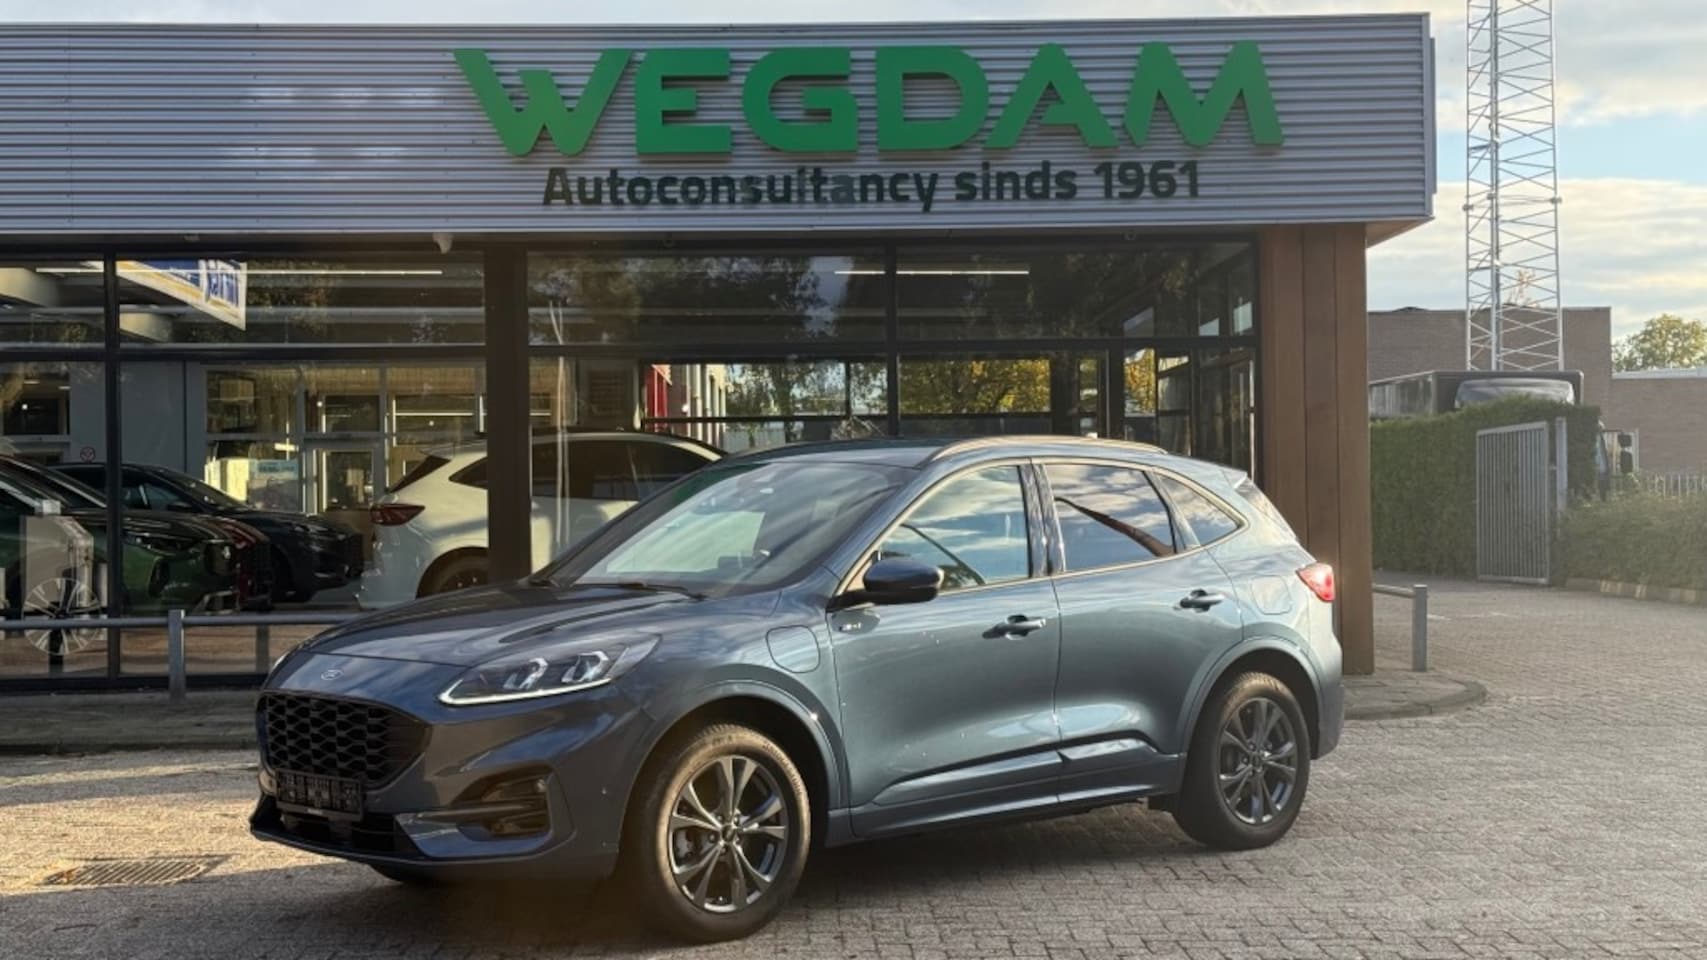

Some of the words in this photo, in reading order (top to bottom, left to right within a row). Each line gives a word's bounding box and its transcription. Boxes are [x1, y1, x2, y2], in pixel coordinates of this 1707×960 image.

[453, 41, 1284, 157] WEGDAM
[543, 166, 940, 213] Autoconsultancy
[955, 161, 1077, 201] sinds
[1093, 160, 1199, 199] 1961
